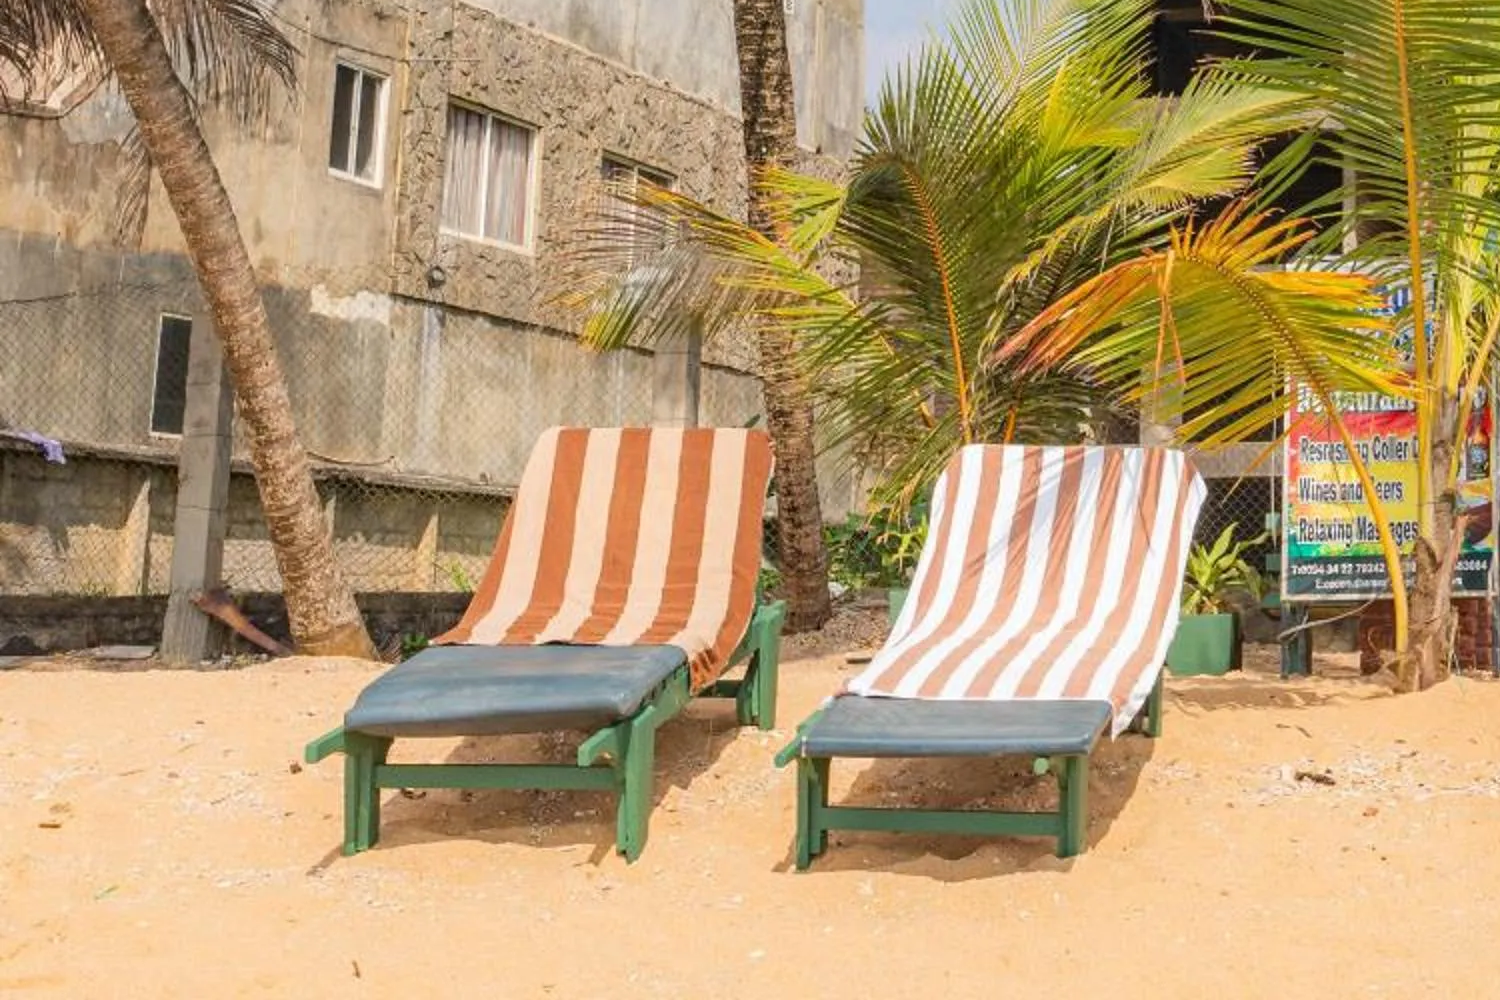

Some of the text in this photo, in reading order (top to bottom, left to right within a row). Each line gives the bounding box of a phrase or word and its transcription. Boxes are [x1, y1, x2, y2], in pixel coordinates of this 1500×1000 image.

[1300, 475, 1403, 501] Wines and eers
[1299, 516, 1419, 548] Relaxing Masages
